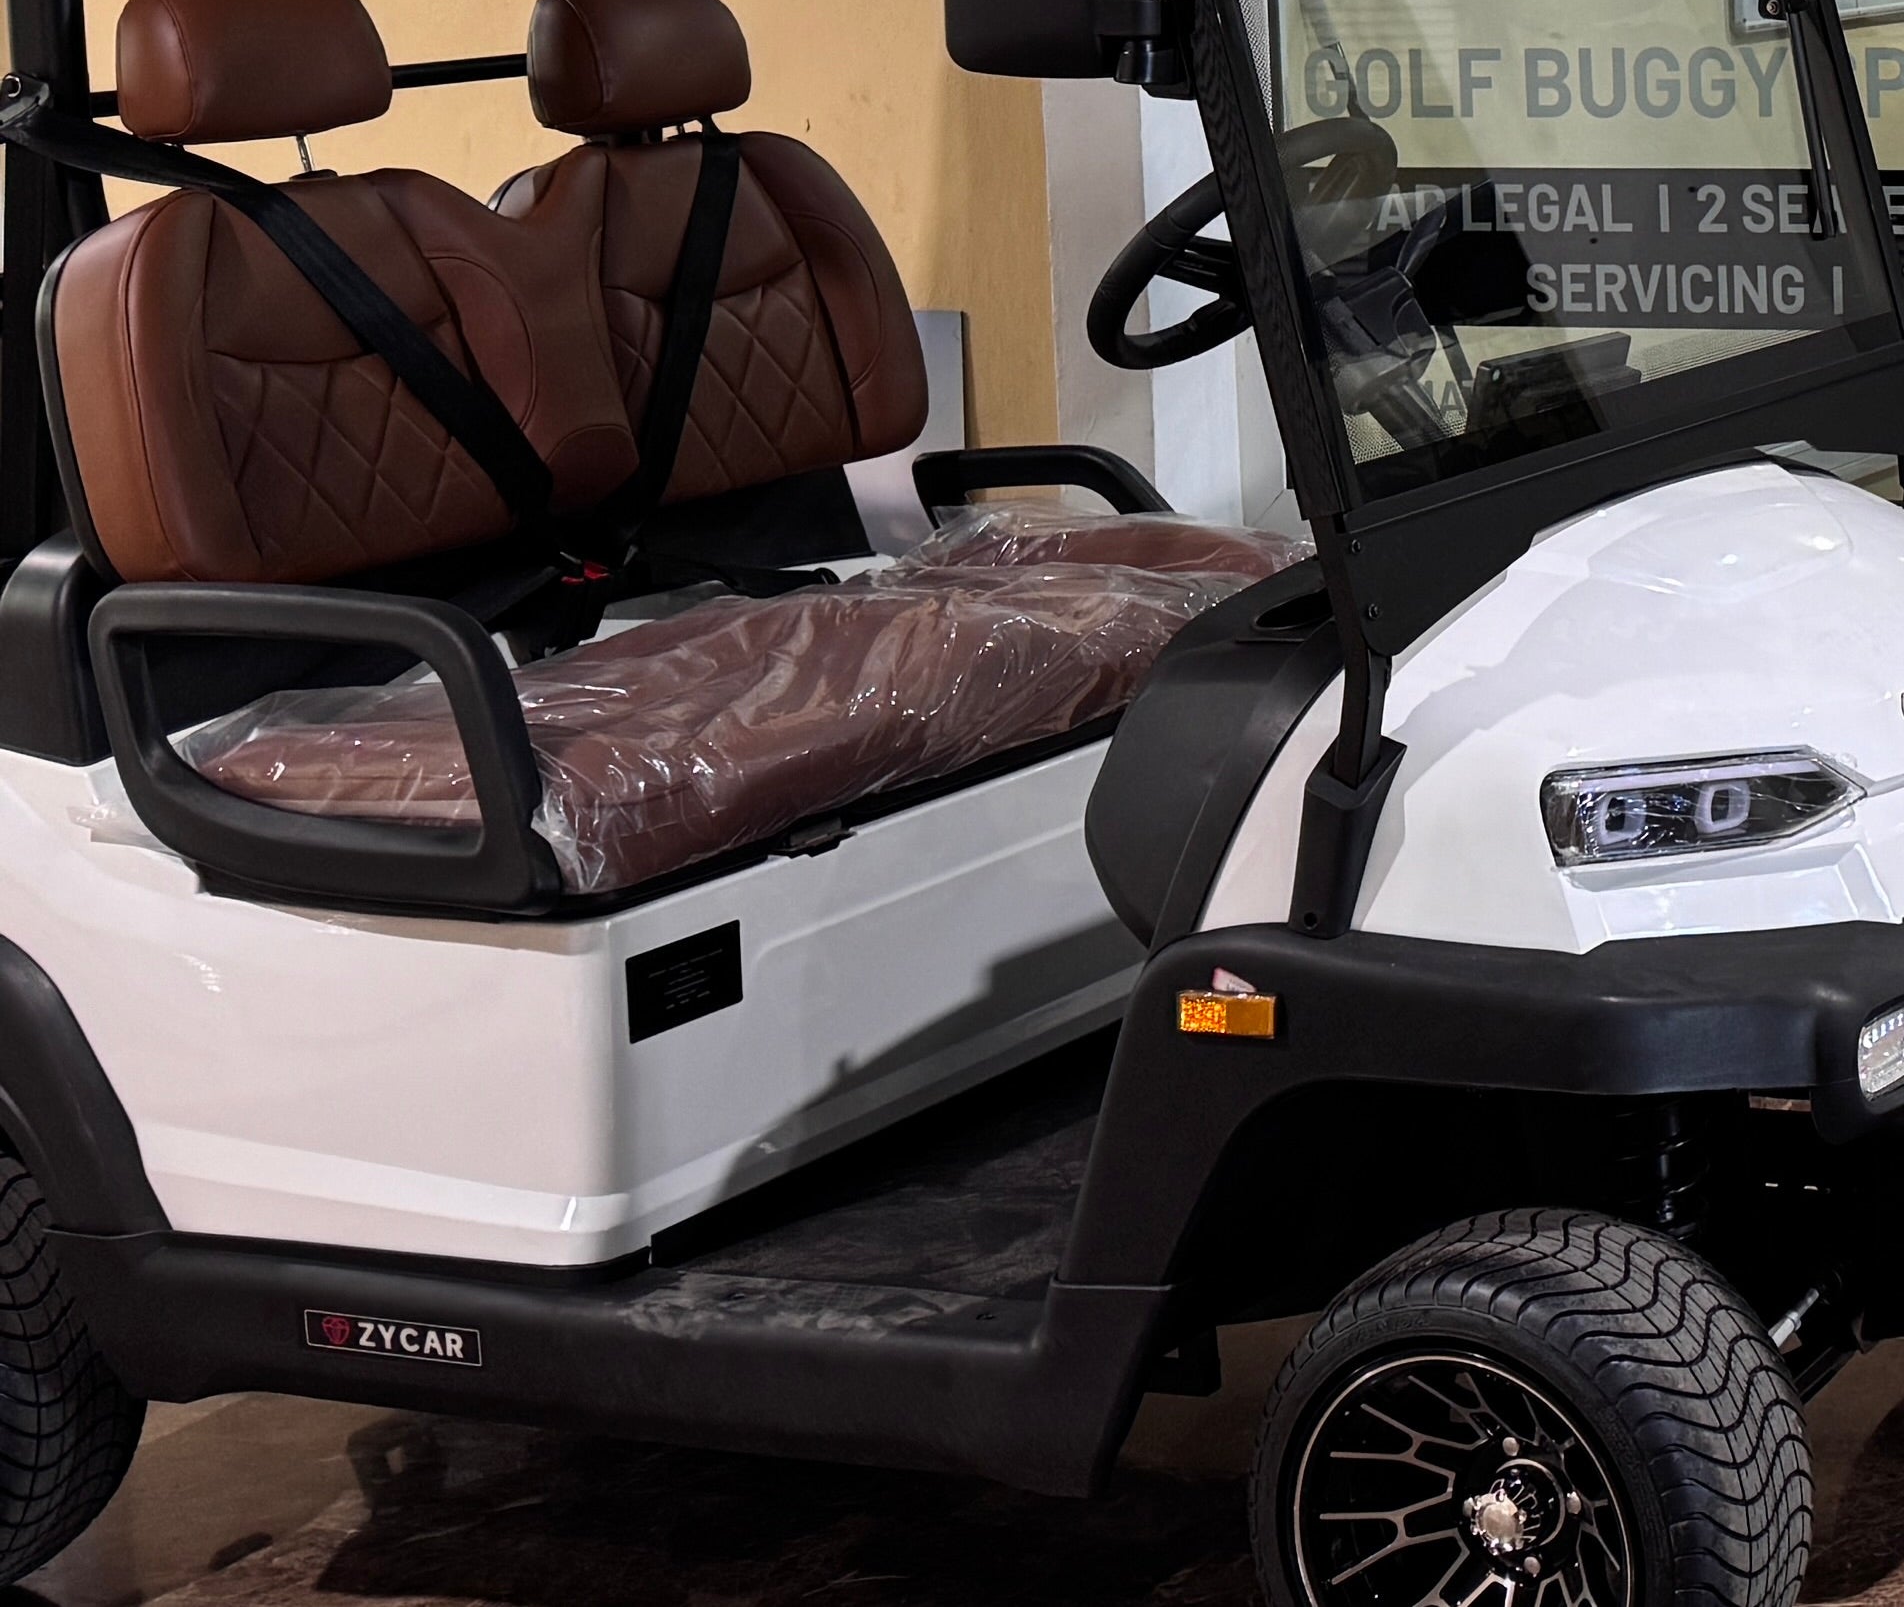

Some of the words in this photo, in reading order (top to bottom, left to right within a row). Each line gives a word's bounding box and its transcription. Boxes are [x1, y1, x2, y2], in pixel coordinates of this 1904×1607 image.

[1304, 47, 1501, 119] GOLF
[1524, 46, 1788, 120] BUGGY
[1461, 182, 1633, 233] LEGAL
[1697, 184, 1728, 233] 2
[1526, 263, 1805, 315] SERVICING
[358, 1322, 464, 1359] ZYCAR
